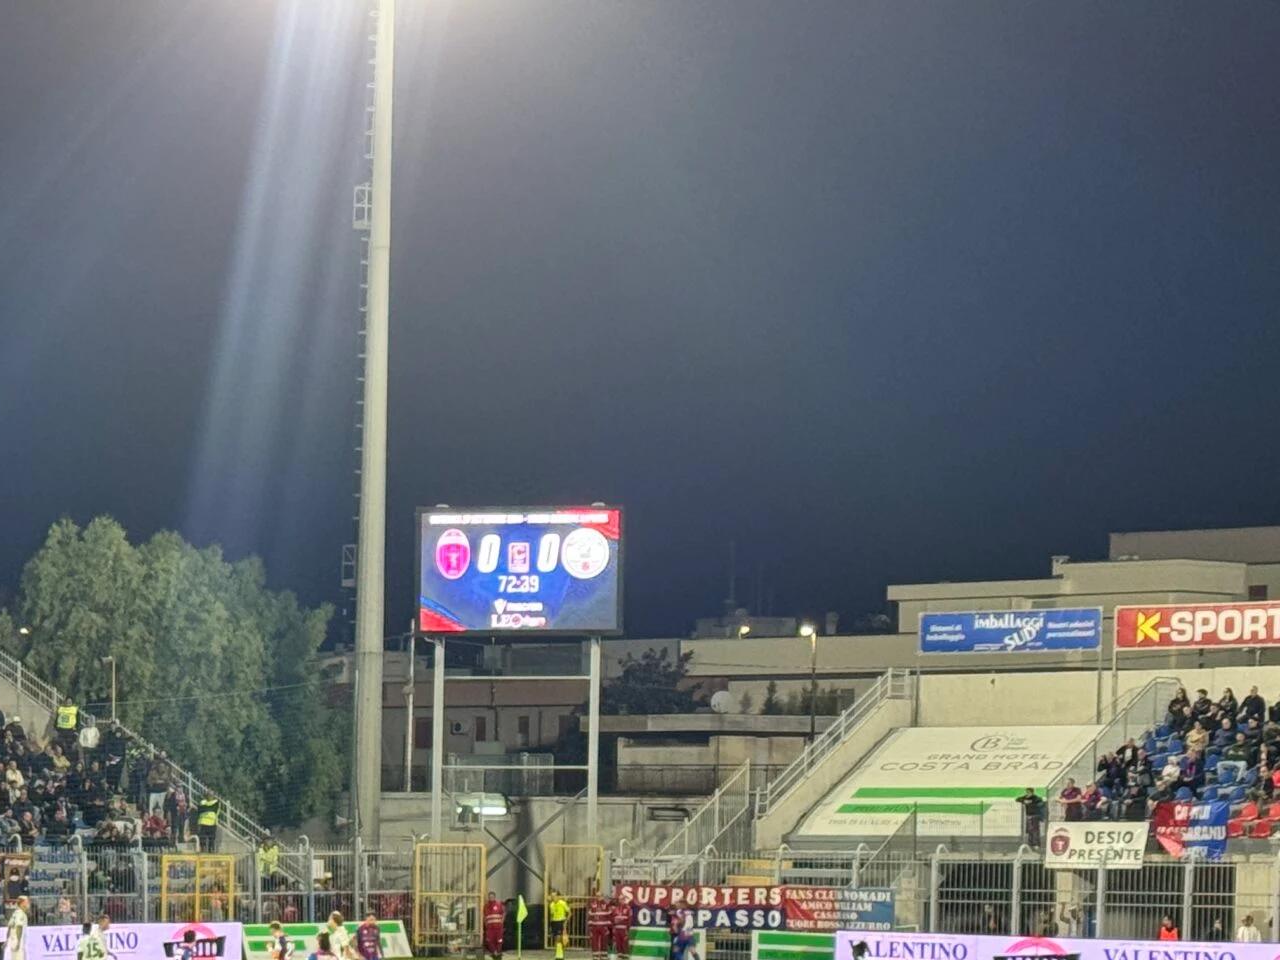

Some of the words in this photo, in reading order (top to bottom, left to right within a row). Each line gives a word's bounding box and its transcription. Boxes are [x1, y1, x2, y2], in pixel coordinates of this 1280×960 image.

[477, 534, 501, 573] 0
[537, 533, 561, 573] 0
[1003, 623, 1042, 650] SUD
[927, 753, 989, 761] GRAND
[993, 752, 1052, 760] HOTEL
[880, 761, 971, 772] COSTA
[982, 761, 1066, 771] BRAD
[1084, 831, 1134, 844] DESIO
[1068, 847, 1142, 861] PRESENTE
[621, 886, 782, 906] SUPPORTERS
